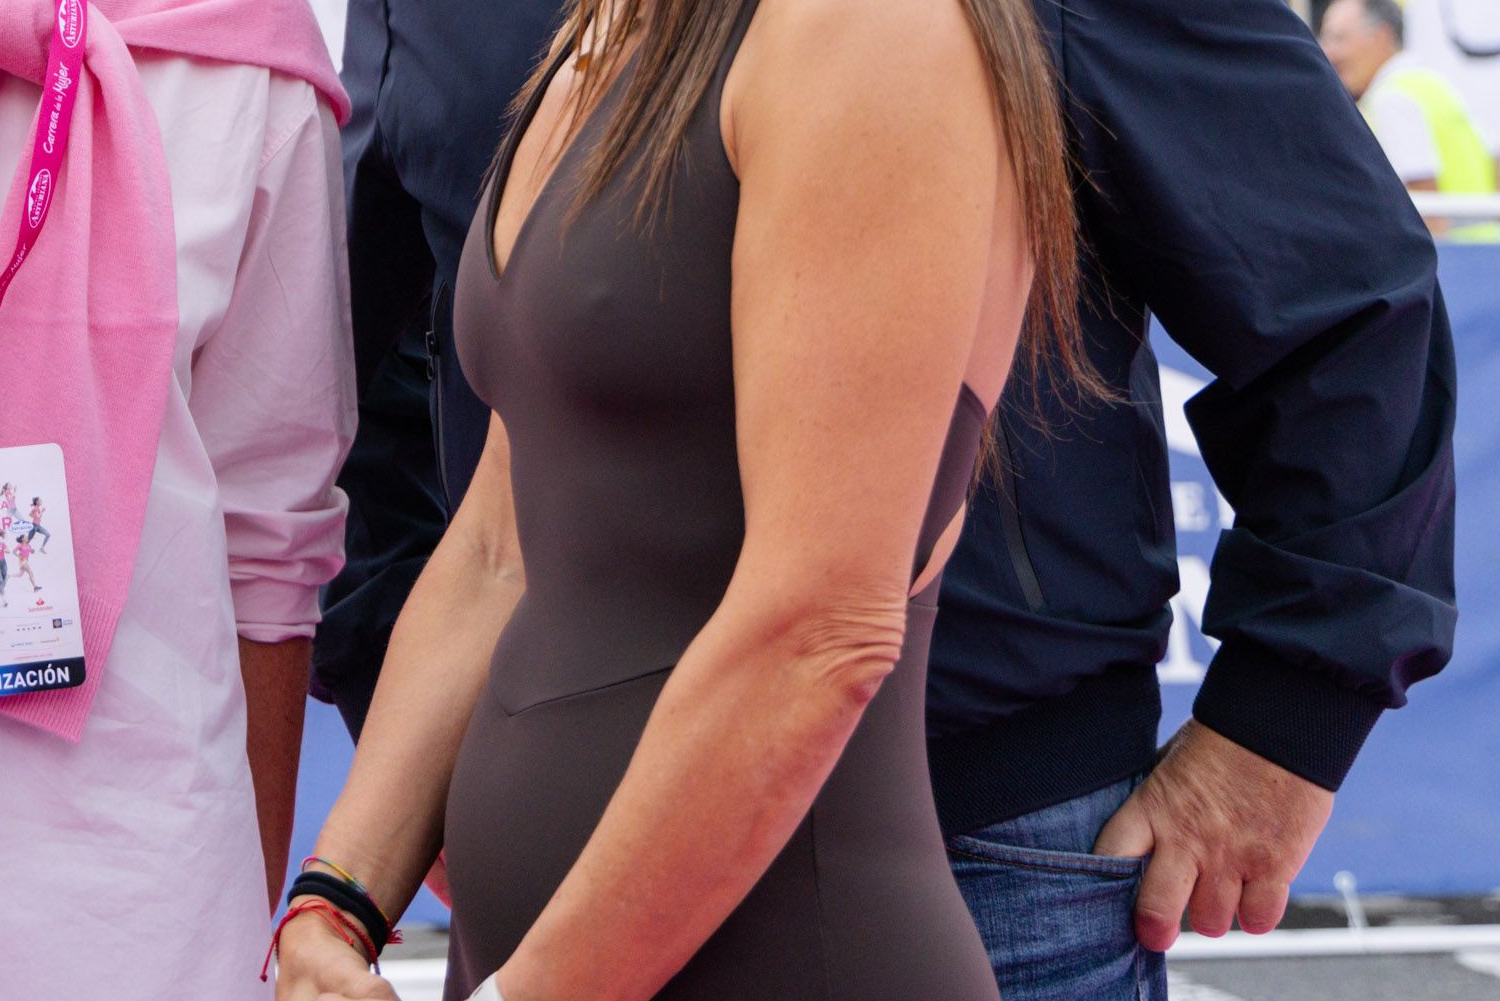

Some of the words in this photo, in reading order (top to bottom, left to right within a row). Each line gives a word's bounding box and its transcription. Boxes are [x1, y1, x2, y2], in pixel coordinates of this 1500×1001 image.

[43, 110, 60, 154] Carrera
[53, 61, 72, 97] Mujer
[31, 174, 49, 223] ASTURIANA
[10, 242, 27, 273] Mujer
